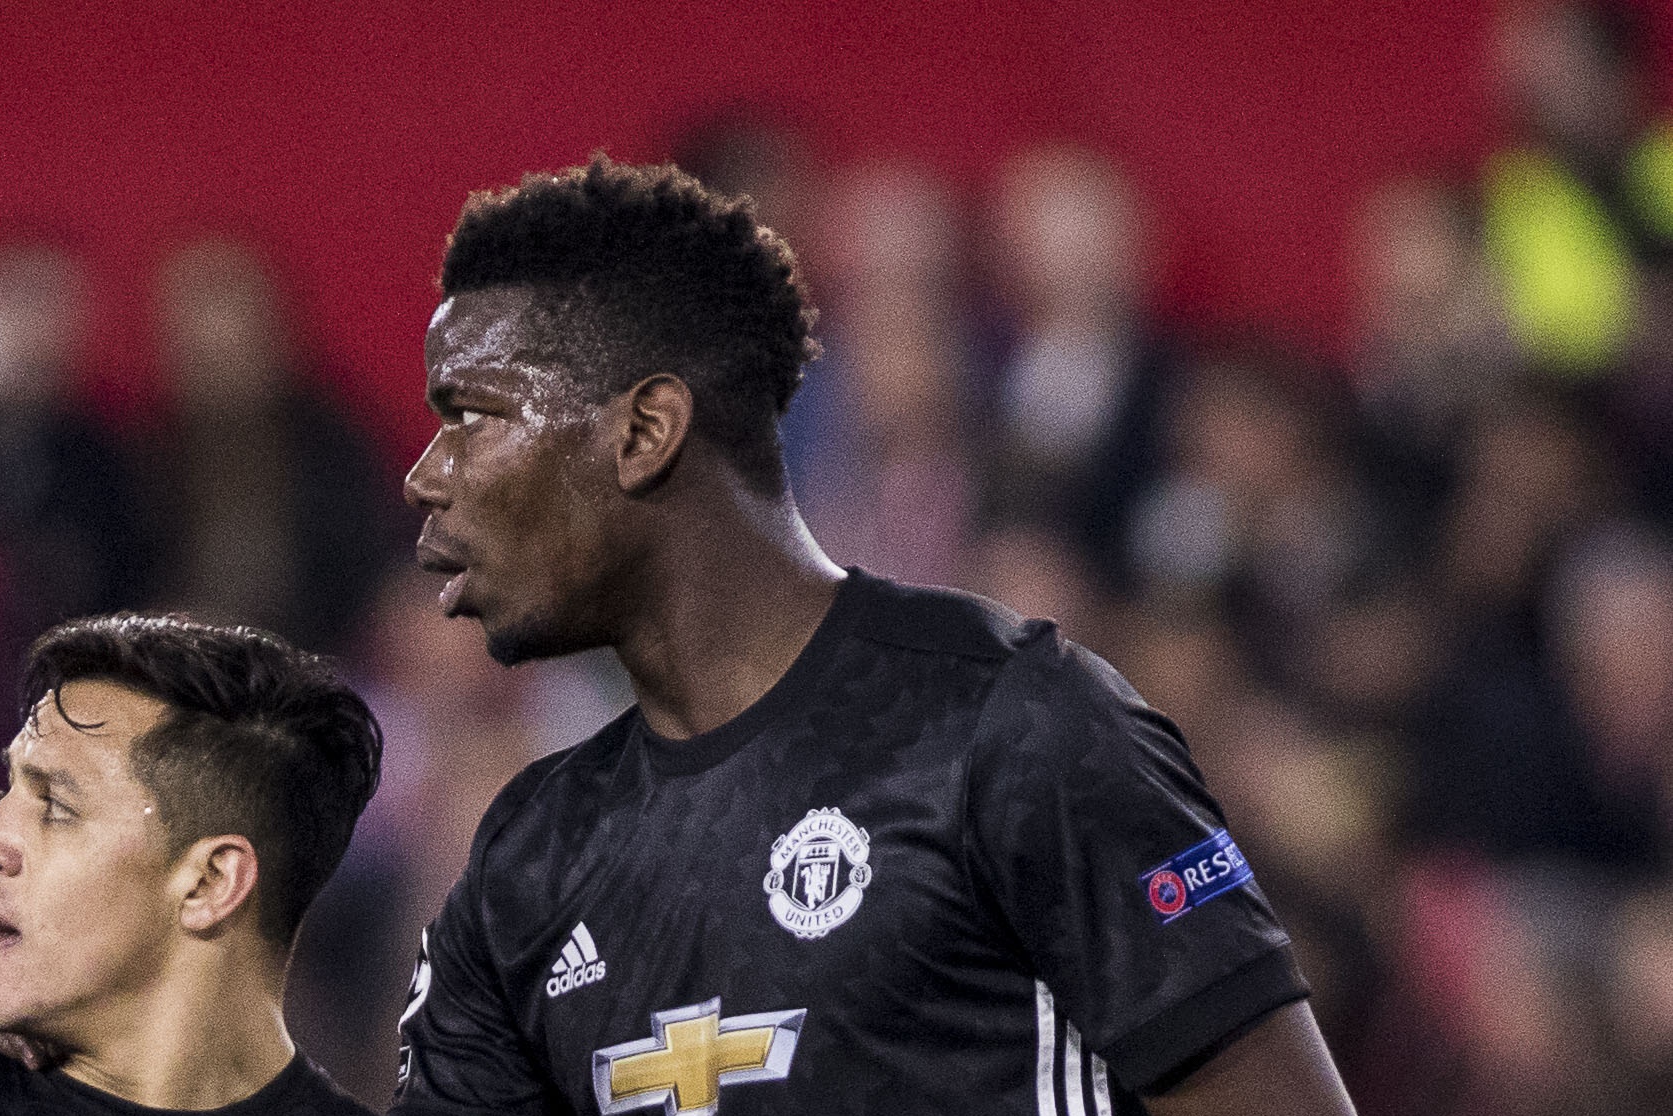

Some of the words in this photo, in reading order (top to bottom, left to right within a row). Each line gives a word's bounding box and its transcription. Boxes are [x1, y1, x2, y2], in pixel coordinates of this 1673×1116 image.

[780, 819, 860, 860] MANCHESTER
[785, 906, 844, 927] UNITED
[546, 960, 607, 998] adidas
